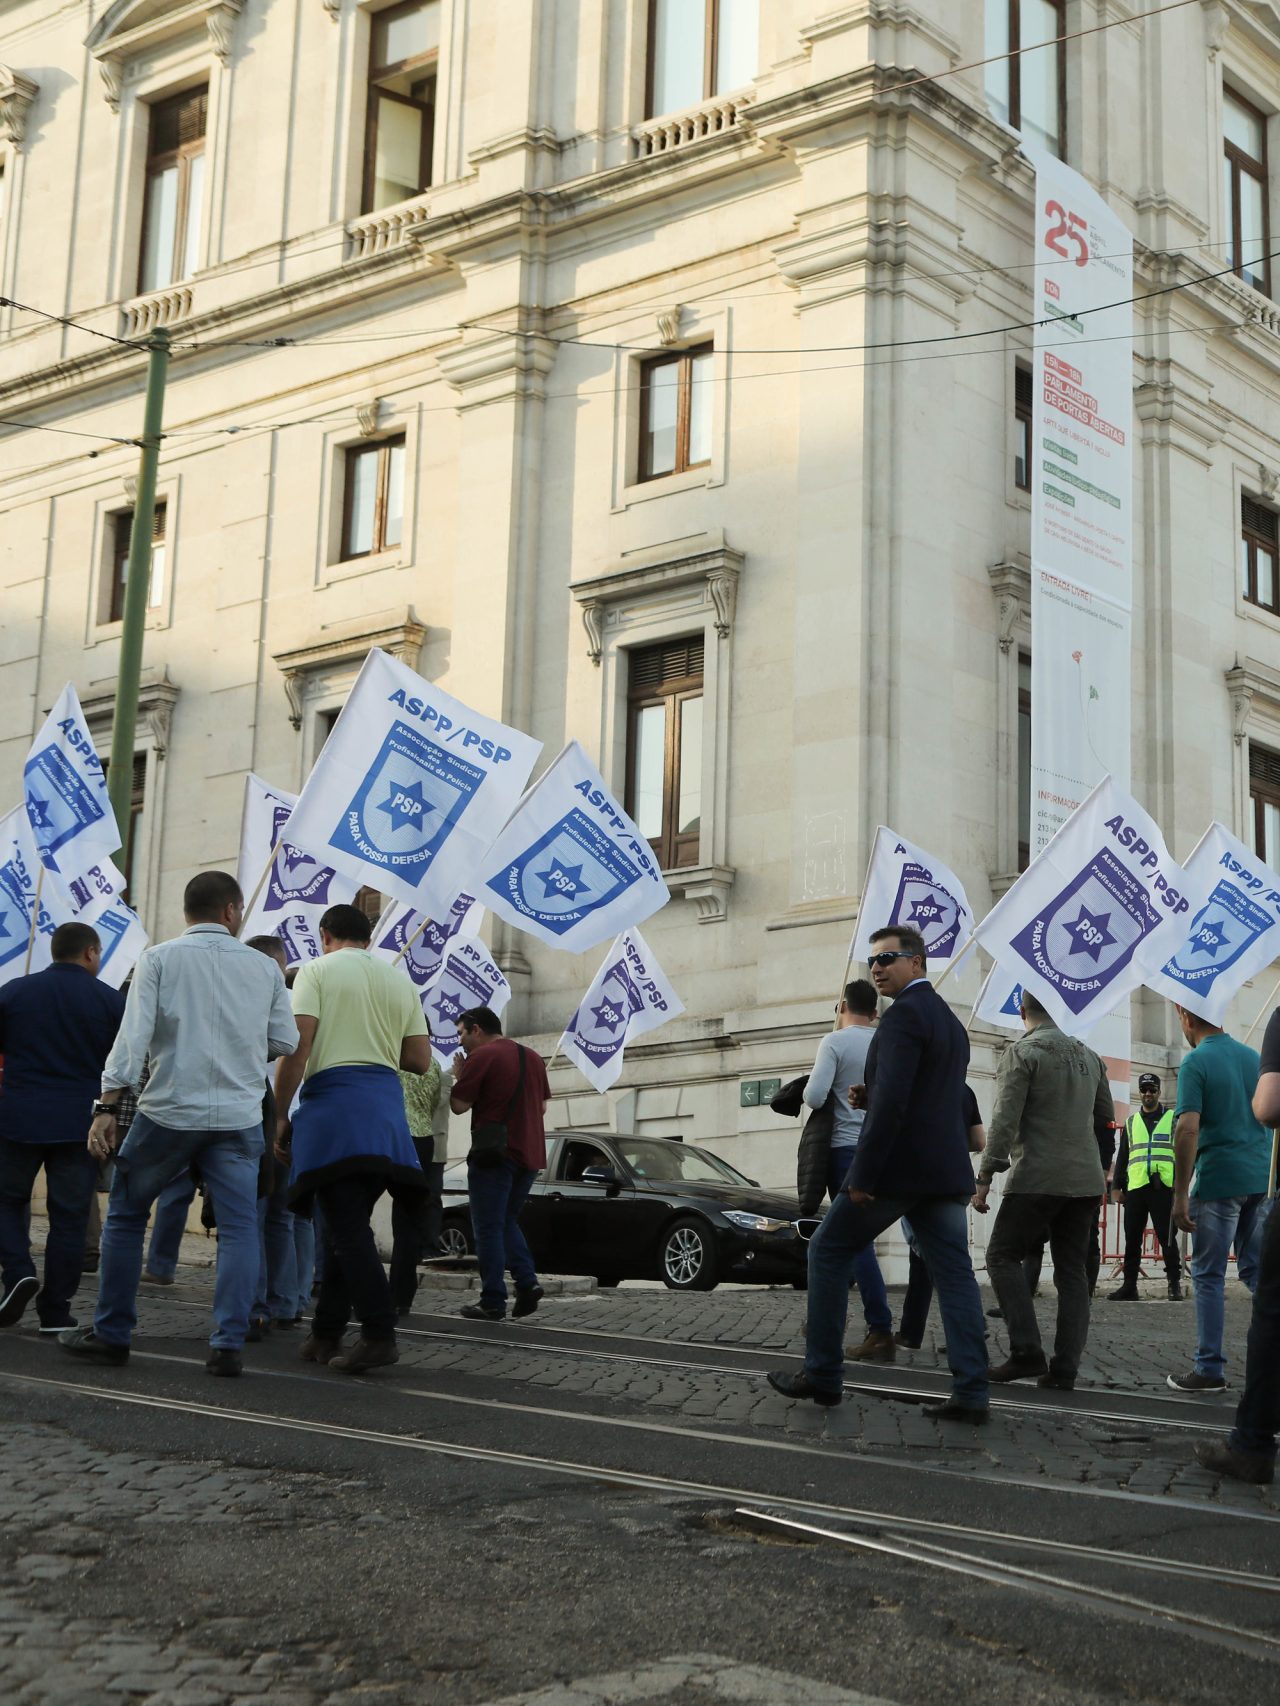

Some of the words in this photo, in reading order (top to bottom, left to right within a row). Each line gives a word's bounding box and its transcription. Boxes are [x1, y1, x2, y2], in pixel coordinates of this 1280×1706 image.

[1045, 199, 1088, 267] 25
[1046, 281, 1060, 298] 10h
[1046, 354, 1058, 369] 15h
[1069, 369, 1081, 383] 18h
[1045, 374, 1097, 411] PARLAMENTO
[1045, 391, 1057, 405] DE
[1058, 399, 1089, 423] PORTAS
[1090, 417, 1124, 444] ABERTAS
[1041, 571, 1070, 592] ENTRADA
[1071, 585, 1089, 600] LIVRE
[387, 688, 512, 764] ASPP/PSP
[388, 739, 435, 770] Profissionais
[435, 766, 446, 777] da
[446, 772, 472, 792] Polícia
[395, 726, 443, 758] Associação
[447, 756, 482, 780] Sindical
[427, 753, 440, 765] dos
[391, 792, 422, 817] PSP
[349, 811, 361, 841] PARA
[356, 840, 388, 863] NOSSA
[391, 848, 432, 865] DEFESA
[573, 779, 659, 882] ASPP/PSP
[562, 822, 600, 857] Profissionais
[599, 855, 608, 863] da
[607, 861, 628, 884] Polícia
[572, 813, 611, 849] Associação
[611, 850, 639, 877] Sindical
[595, 843, 606, 853] dos
[1101, 853, 1139, 893] Associação
[1104, 815, 1190, 915] ASPP/PSP
[508, 866, 519, 894] PARA
[548, 869, 577, 893] PSP
[1091, 864, 1128, 905] Profissionais
[1127, 903, 1135, 912] da
[511, 892, 536, 917] NOSSA
[1124, 888, 1134, 900] dos
[539, 912, 582, 921] DEFESA
[915, 905, 938, 917] PSP
[1248, 905, 1272, 924] Sindical
[426, 923, 446, 945] PSP
[927, 931, 955, 953] DEFESA
[1032, 920, 1045, 950] PARA
[1075, 918, 1104, 946] PSP
[1197, 928, 1219, 946] PSP
[1033, 952, 1060, 983] NOSSA
[1186, 967, 1220, 980] DEFESA
[1061, 979, 1101, 991] DEFESA
[440, 999, 458, 1015] PSP
[600, 1005, 619, 1023] PSP
[436, 1035, 461, 1045] DEFES
[587, 1044, 617, 1053] DEFESA
